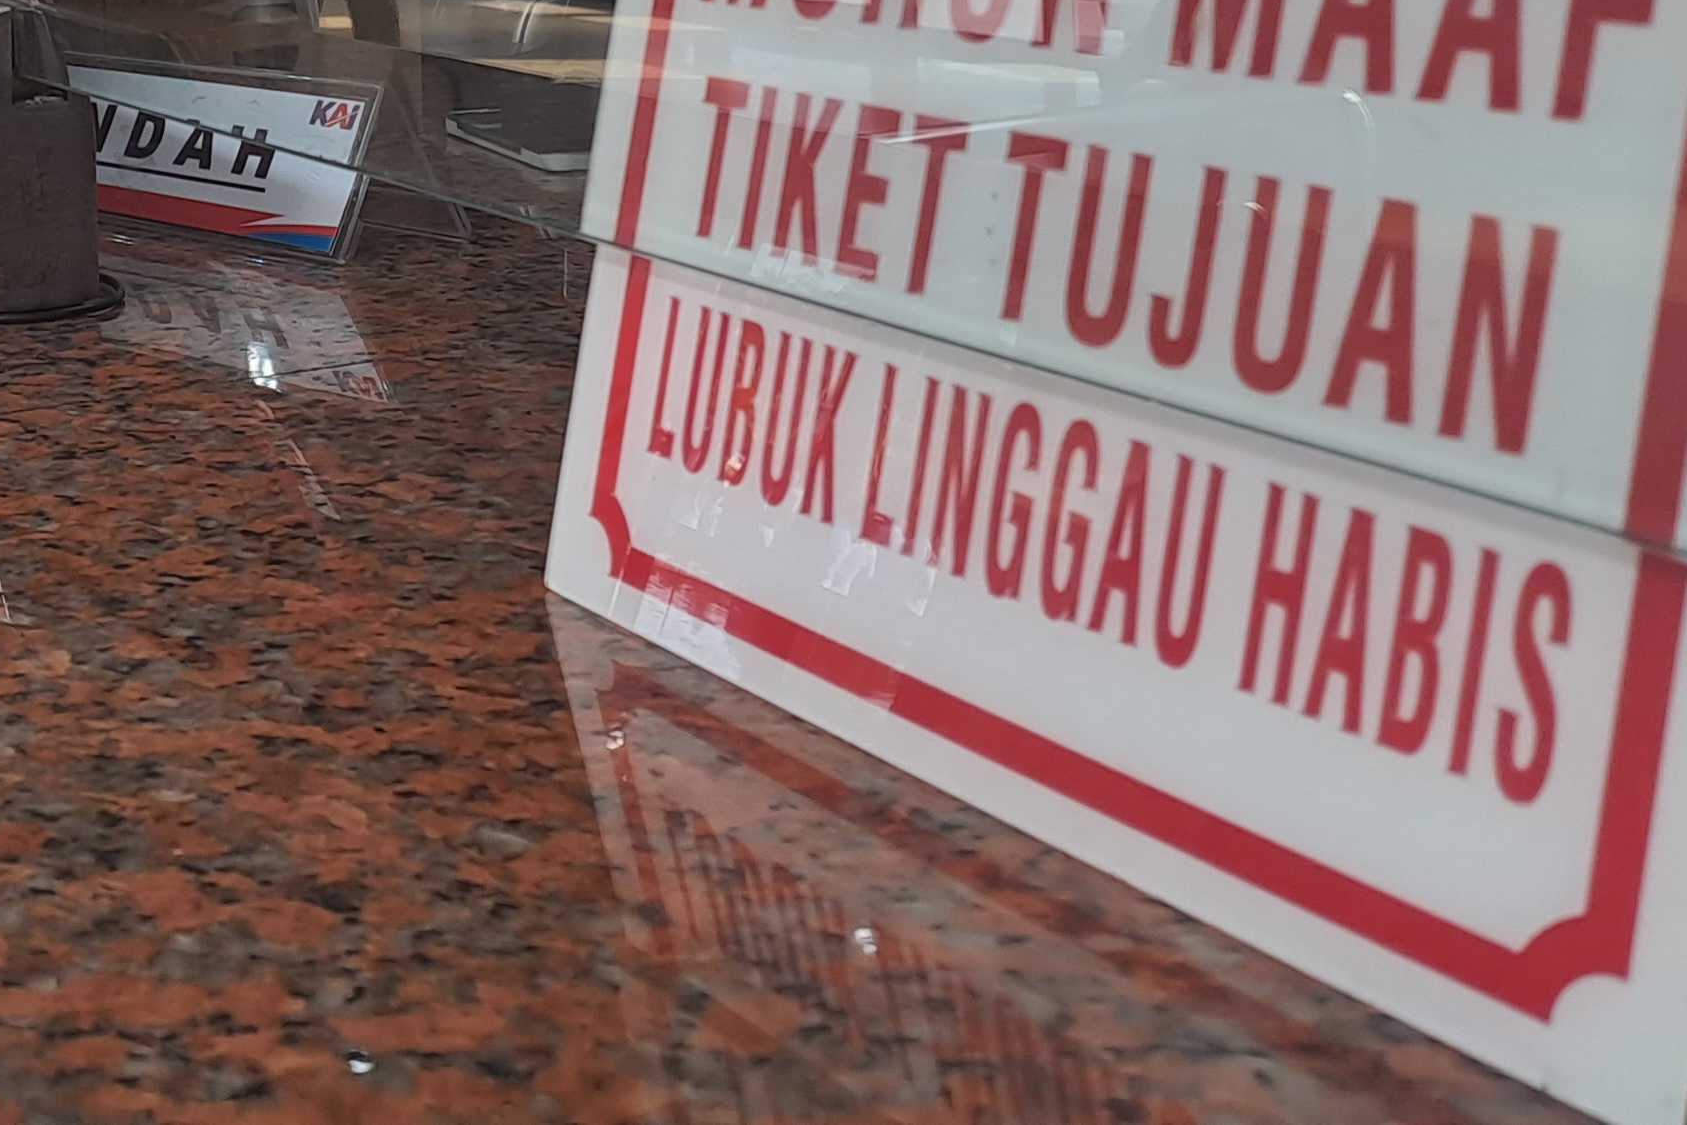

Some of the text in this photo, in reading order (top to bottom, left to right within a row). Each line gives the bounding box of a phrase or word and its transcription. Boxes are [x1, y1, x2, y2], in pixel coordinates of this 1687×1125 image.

[309, 99, 360, 130] KAI
[695, 77, 1560, 456] TIKET TUJUAN
[646, 296, 1574, 806] LUBUK LINGGAU HABIS
